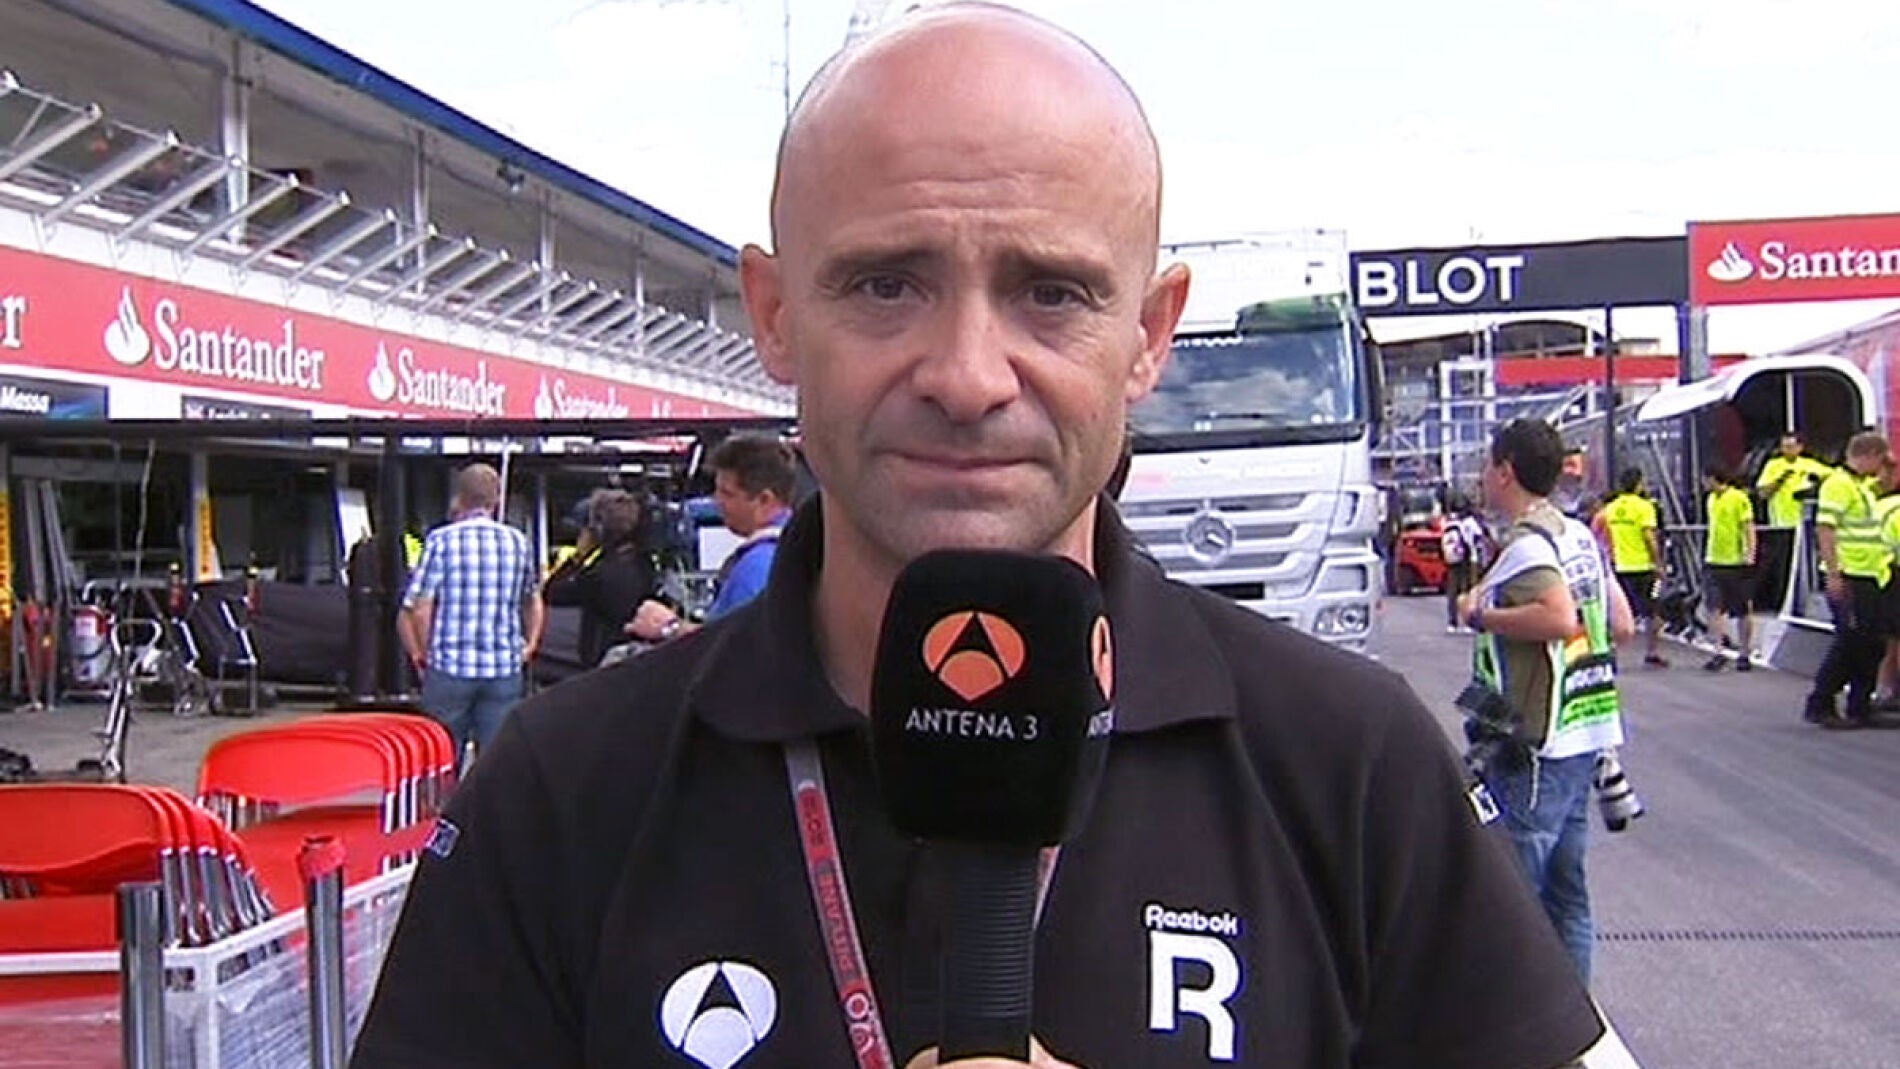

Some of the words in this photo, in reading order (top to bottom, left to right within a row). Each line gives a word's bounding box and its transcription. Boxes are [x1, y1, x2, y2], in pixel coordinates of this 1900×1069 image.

[1358, 254, 1524, 306] BLOT
[154, 298, 325, 390] Santander
[398, 348, 506, 416] Santander
[905, 707, 1015, 739] ANTENA
[1023, 715, 1038, 739] 3
[1145, 904, 1238, 935] Reebok
